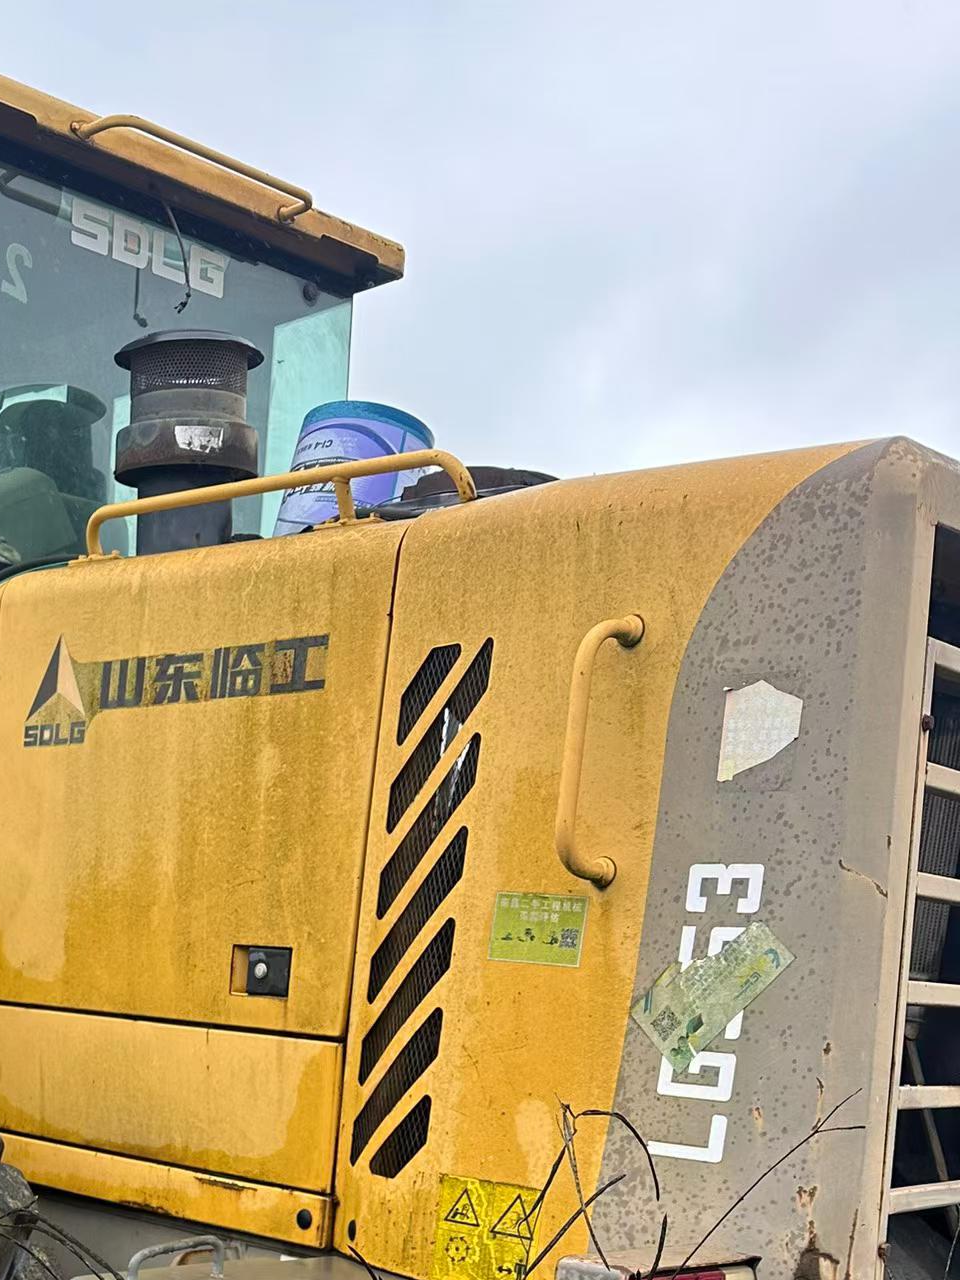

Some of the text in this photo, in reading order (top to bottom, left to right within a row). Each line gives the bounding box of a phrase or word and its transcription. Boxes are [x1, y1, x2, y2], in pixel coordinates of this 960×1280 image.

[70, 197, 226, 299] SDLG
[99, 633, 330, 710] 山东临工
[24, 720, 86, 747] SDLG
[647, 863, 765, 1164] LG53
